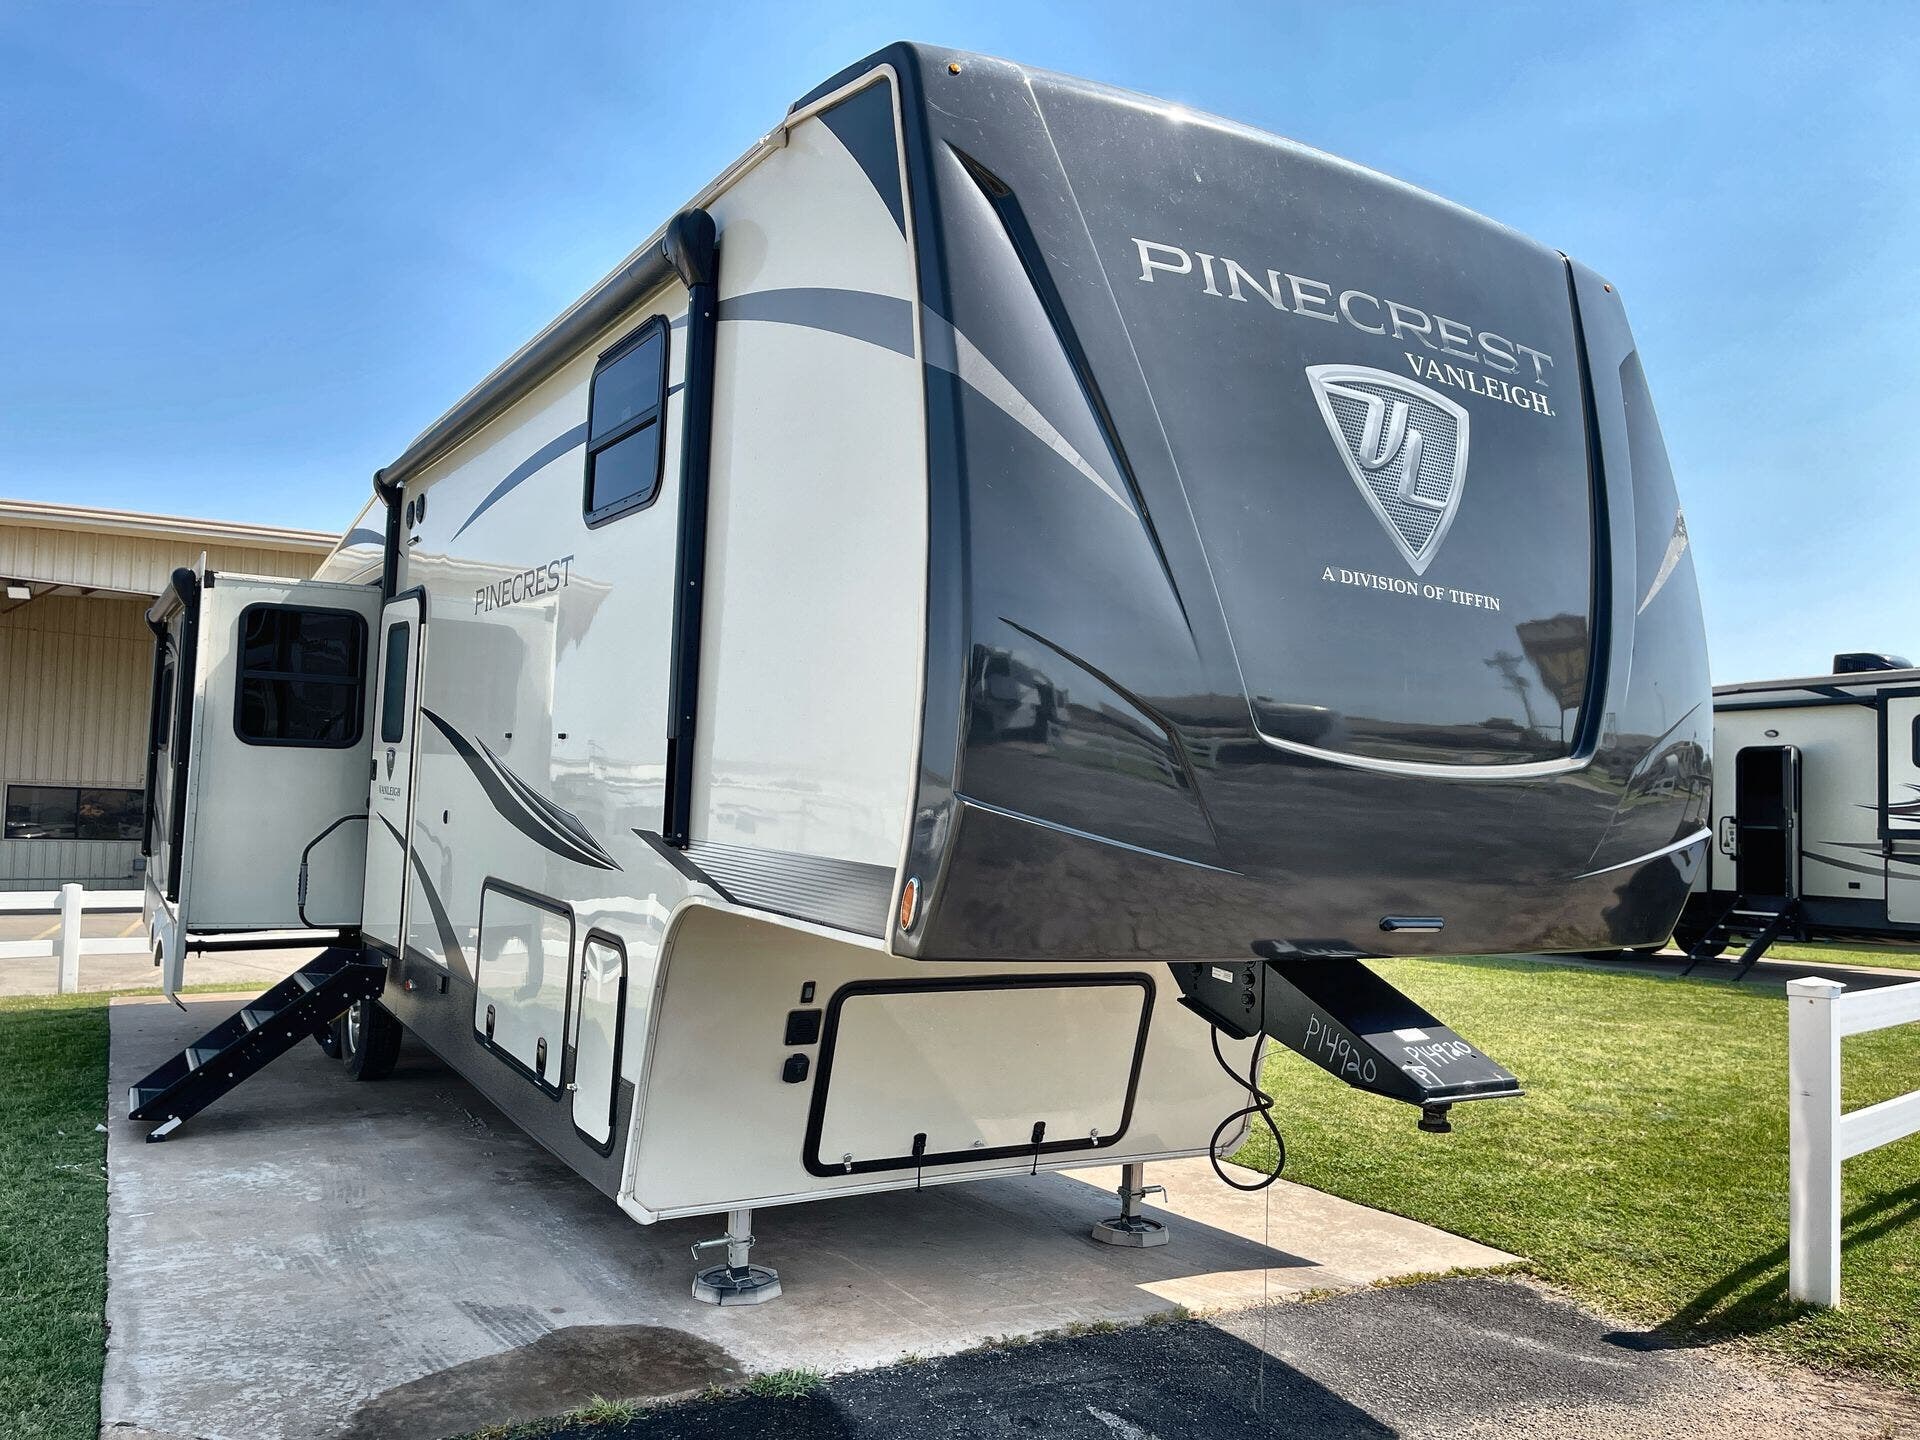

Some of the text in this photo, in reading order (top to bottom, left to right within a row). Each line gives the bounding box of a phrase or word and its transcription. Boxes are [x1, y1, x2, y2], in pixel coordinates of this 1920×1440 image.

[1131, 237, 1554, 387] PINECREST
[474, 554, 575, 616] PINECREST
[1322, 566, 1501, 611] A DIVISION OF TIFFIN
[1303, 1012, 1377, 1083] P14920
[1403, 1040, 1472, 1068] P14920
